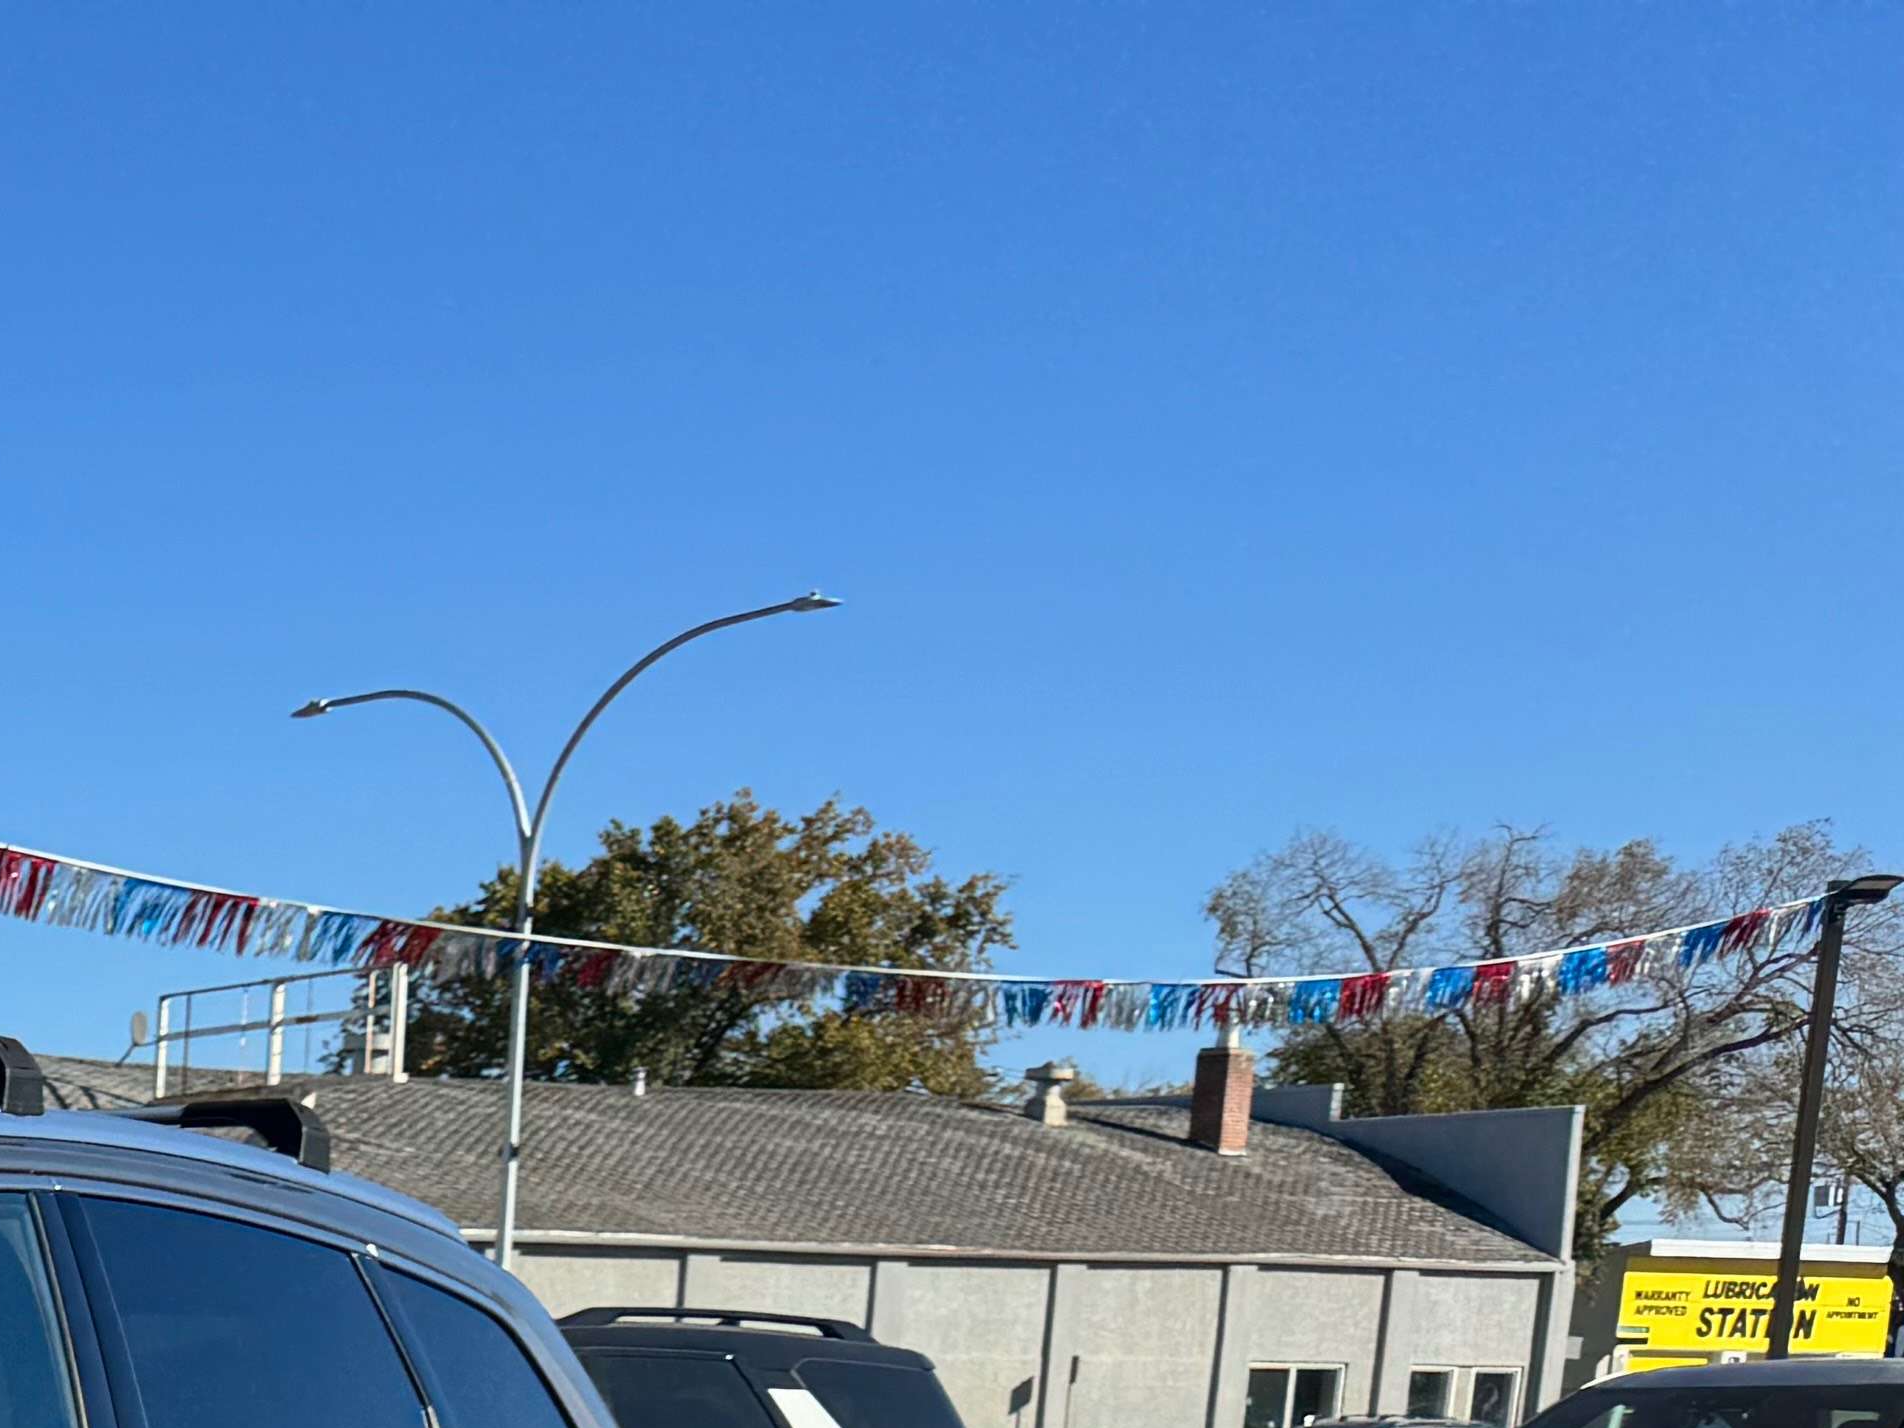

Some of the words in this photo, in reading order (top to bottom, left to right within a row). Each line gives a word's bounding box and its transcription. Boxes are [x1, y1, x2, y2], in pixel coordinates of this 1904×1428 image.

[1635, 1290, 1691, 1302] WARRANTY
[1703, 1279, 1820, 1302] LUBRICN
[1847, 1297, 1860, 1307] NO
[1634, 1305, 1687, 1317] APPROVED
[1696, 1307, 1817, 1340] STATIN
